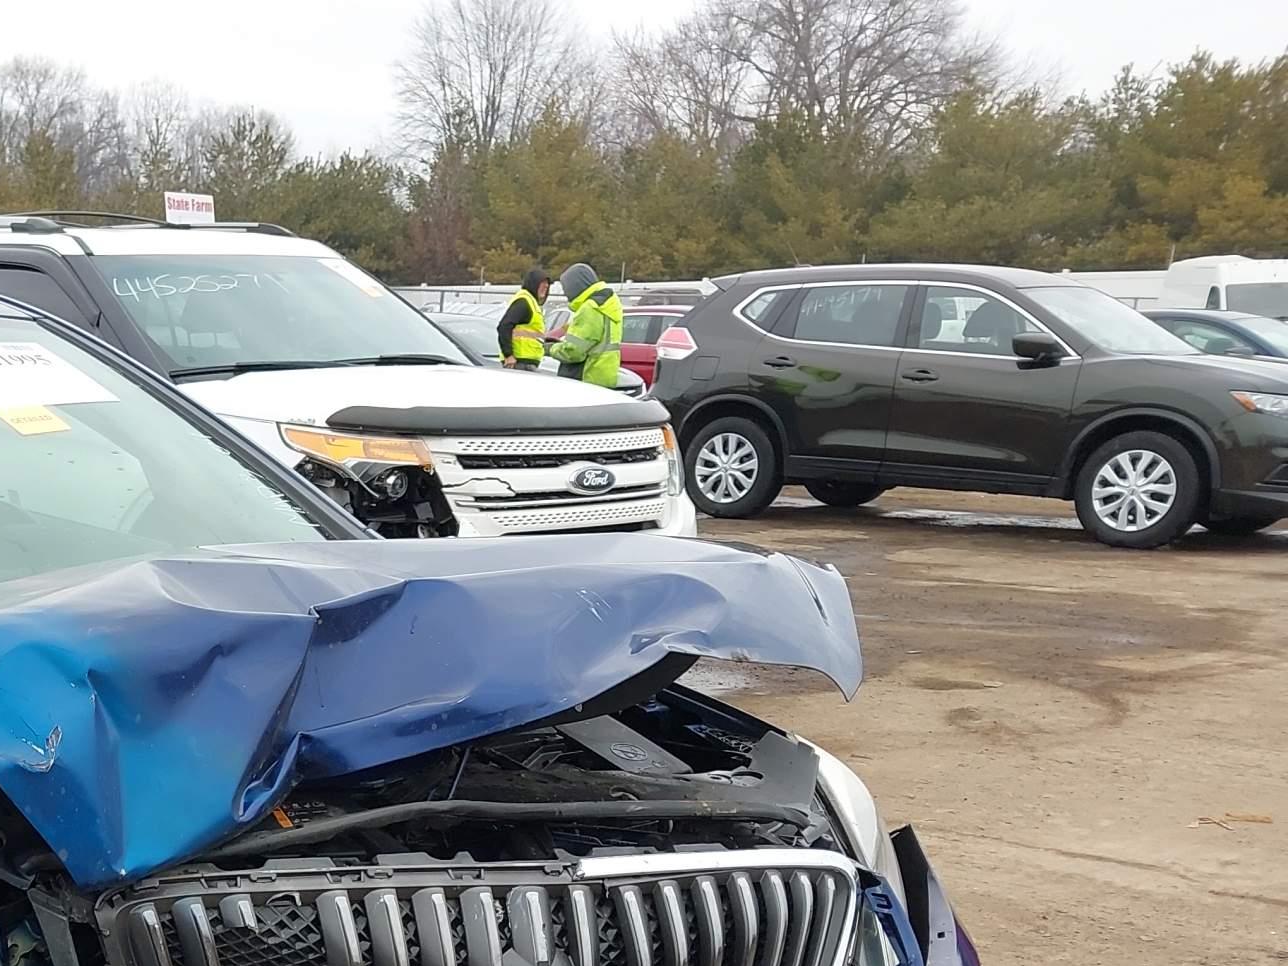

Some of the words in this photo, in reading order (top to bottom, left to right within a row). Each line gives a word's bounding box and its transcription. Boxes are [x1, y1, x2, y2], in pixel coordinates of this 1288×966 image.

[167, 196, 190, 210] State
[191, 198, 213, 212] Farm
[583, 470, 609, 486] Ford
